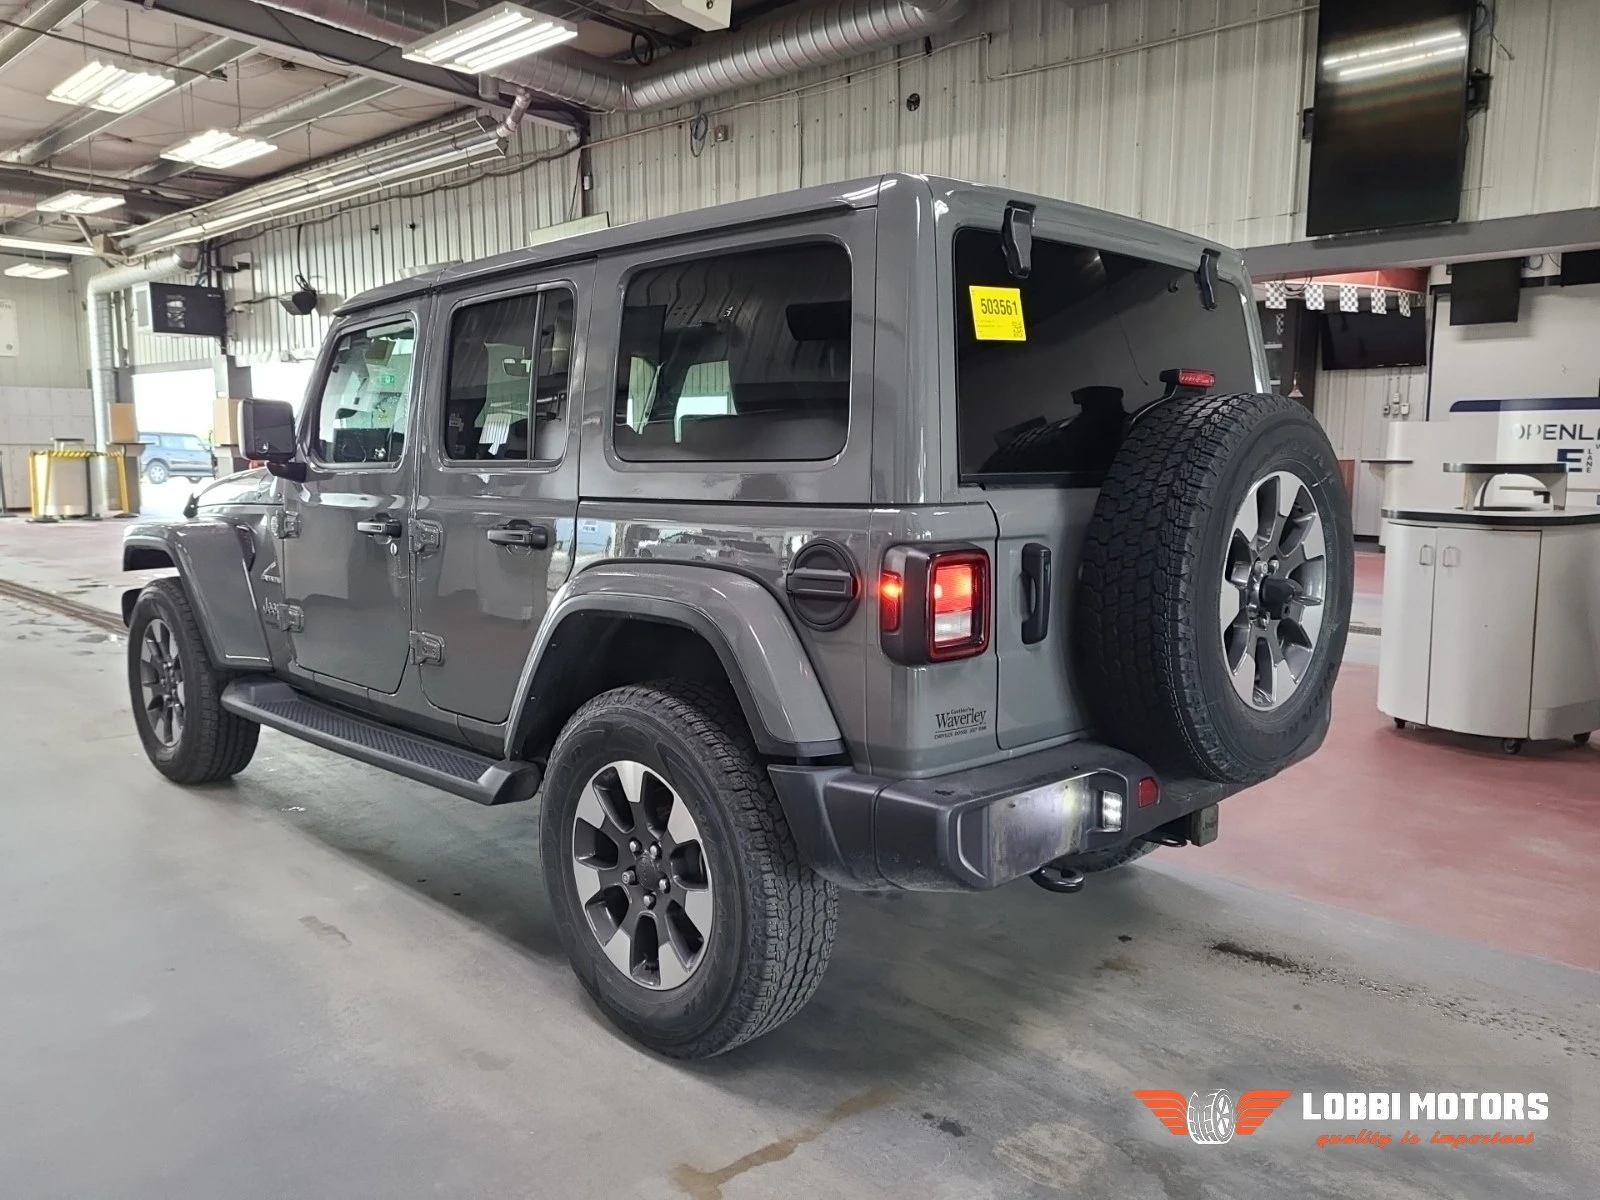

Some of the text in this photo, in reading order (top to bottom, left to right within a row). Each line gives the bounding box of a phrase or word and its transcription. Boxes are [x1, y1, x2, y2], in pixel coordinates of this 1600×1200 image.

[980, 298, 1018, 316] 503561
[1513, 424, 1600, 440] PENL
[935, 707, 987, 729] Waverley
